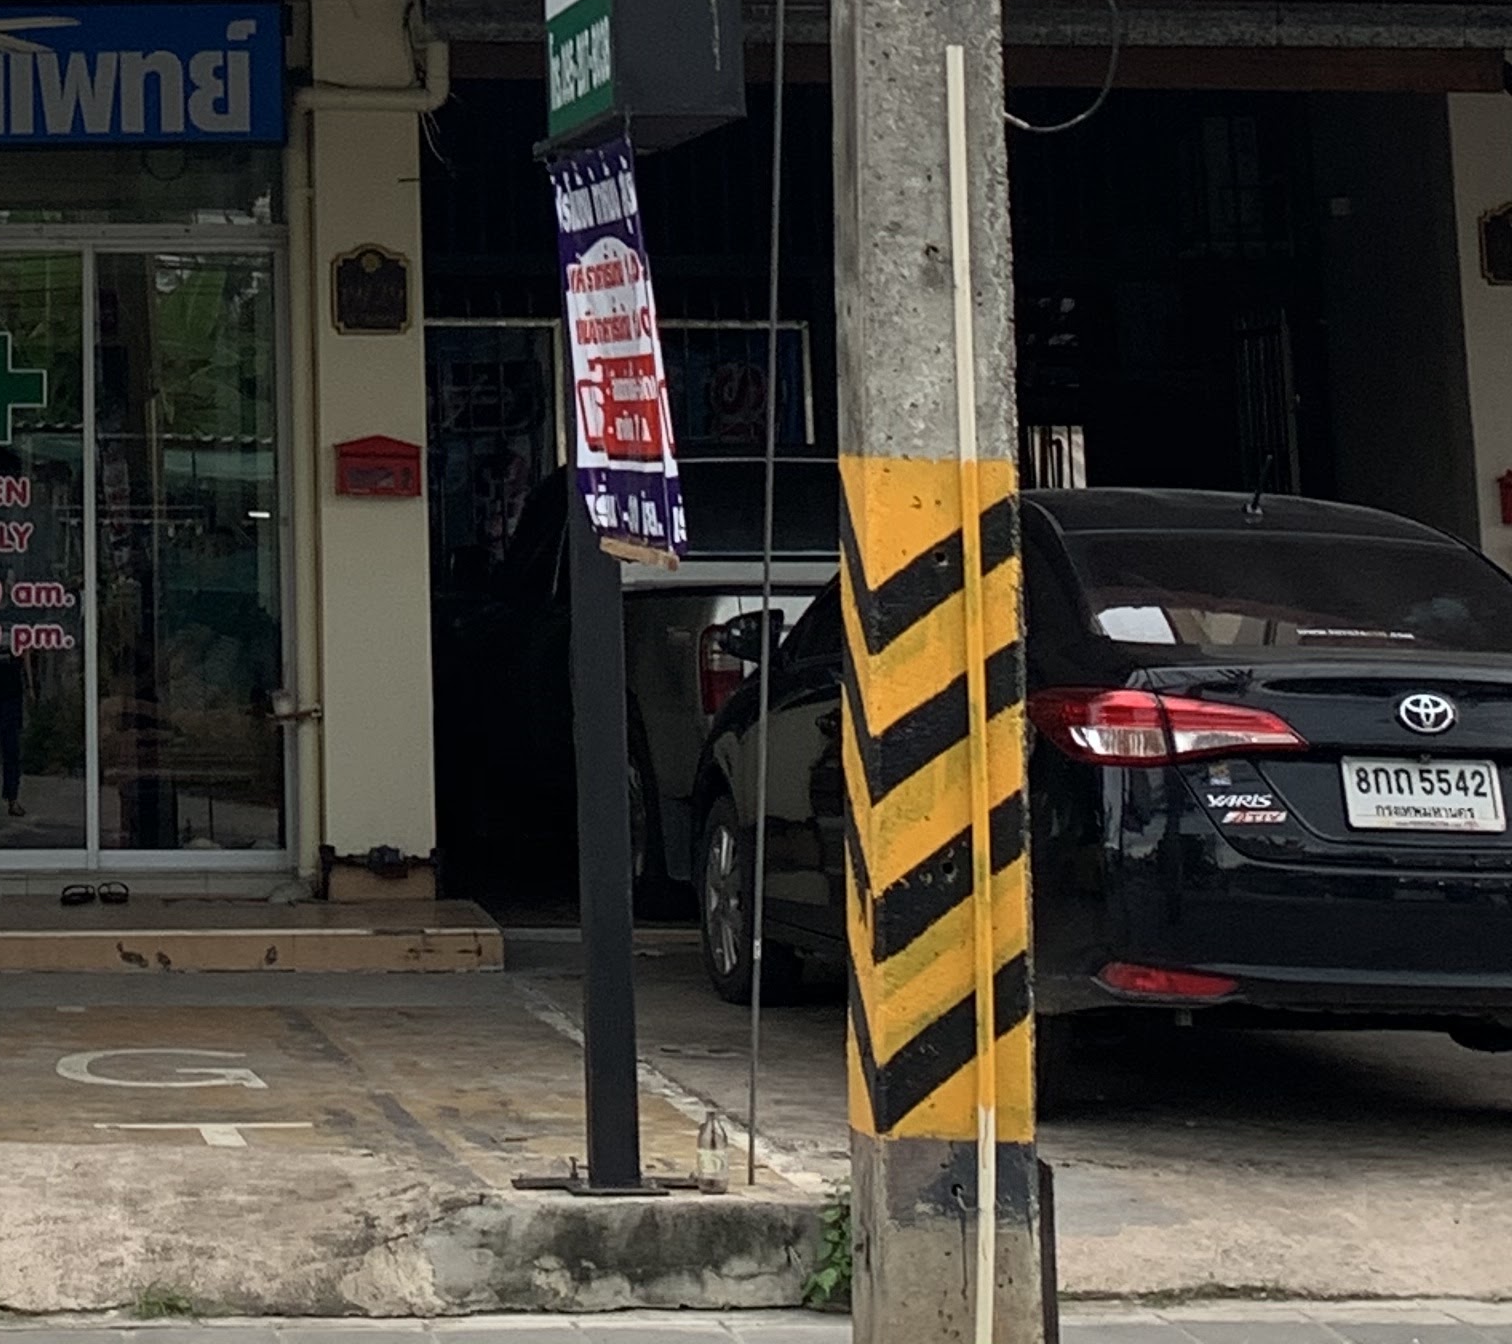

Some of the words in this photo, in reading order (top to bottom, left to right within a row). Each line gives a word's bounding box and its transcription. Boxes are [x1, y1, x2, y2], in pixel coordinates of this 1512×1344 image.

[10, 581, 77, 609] am.
[10, 624, 77, 658] pm.
[1419, 769, 1488, 798] 5542
[1206, 793, 1273, 809] YARIS
